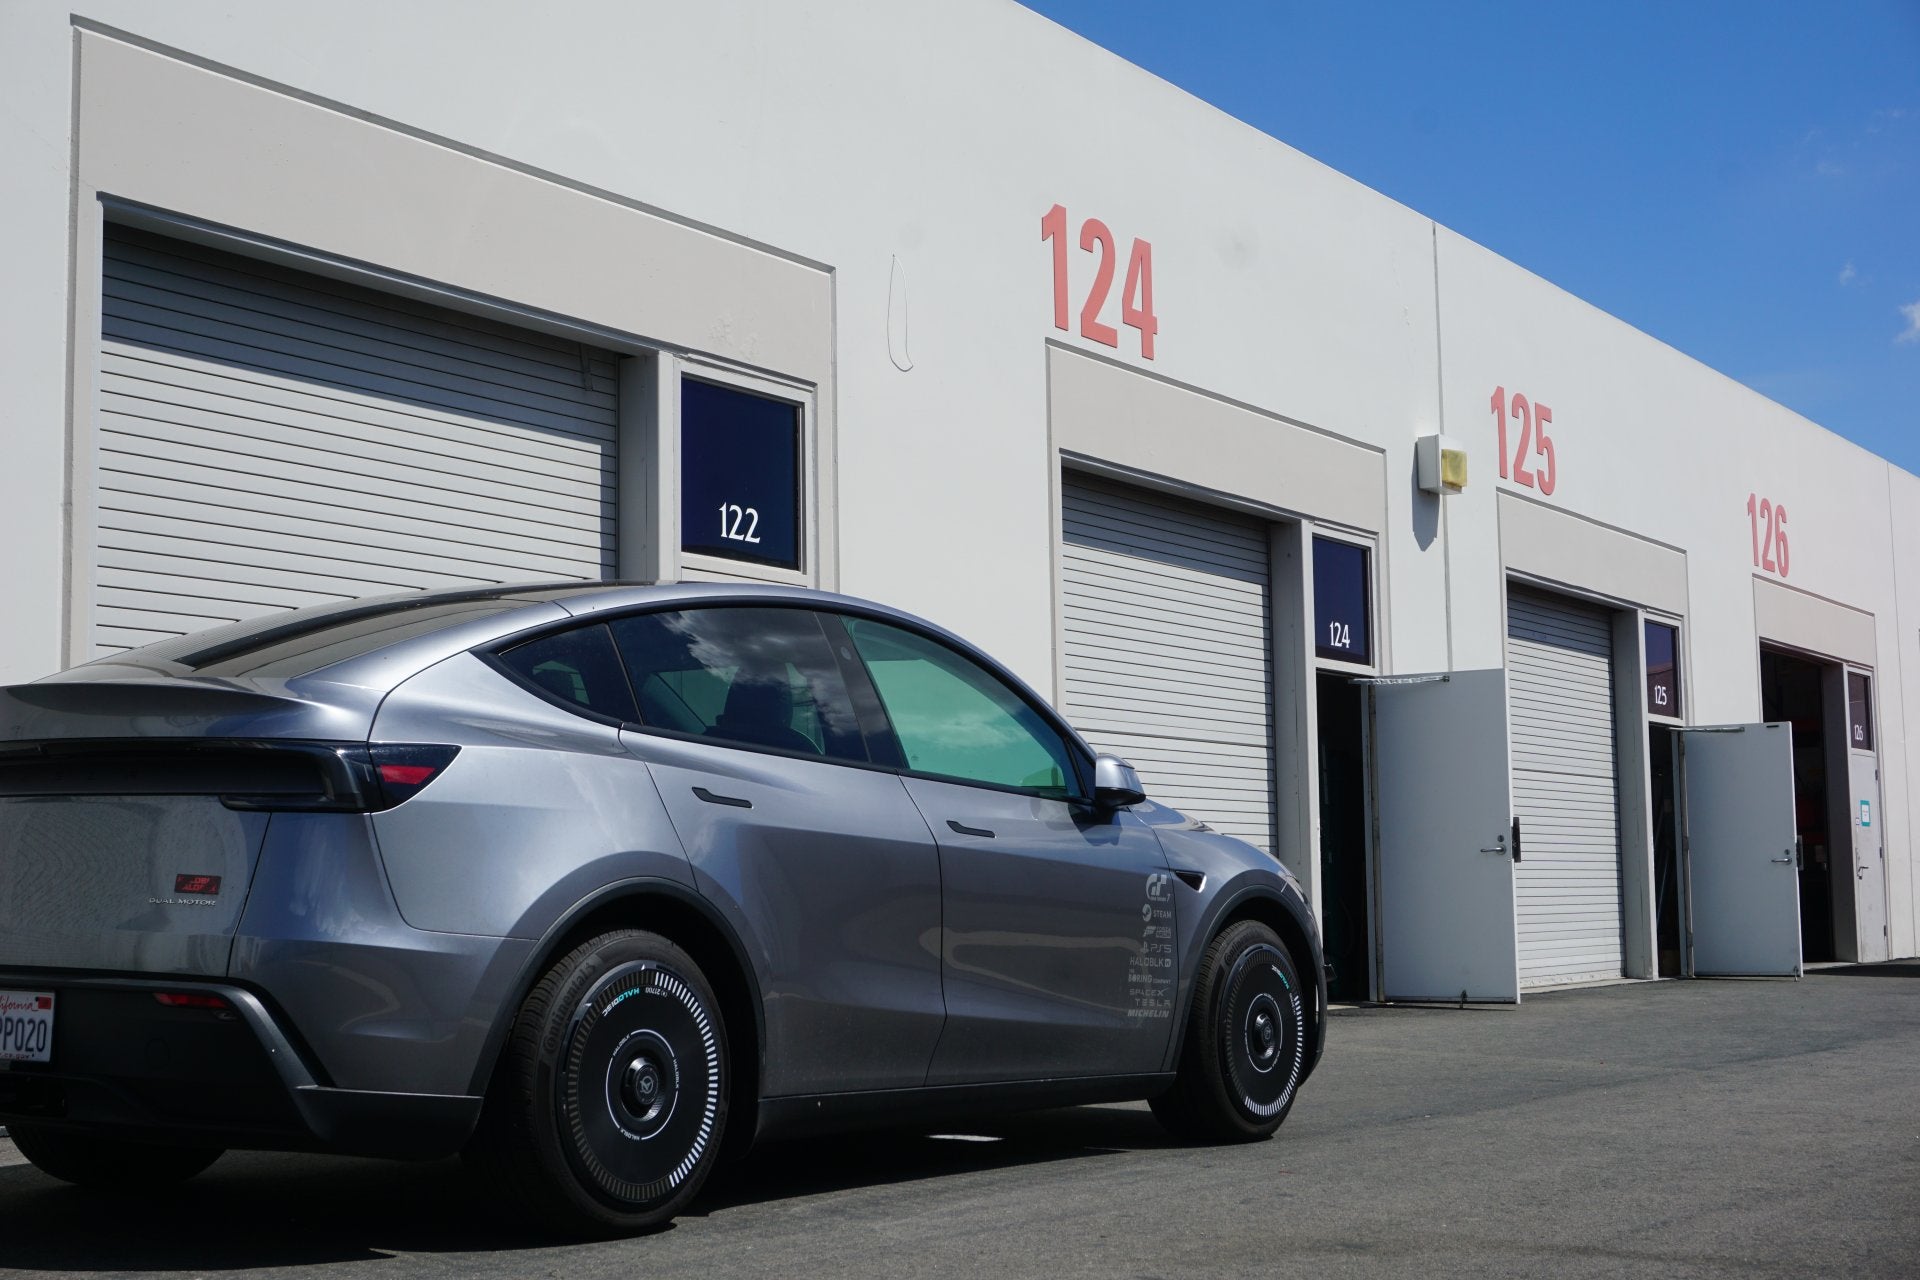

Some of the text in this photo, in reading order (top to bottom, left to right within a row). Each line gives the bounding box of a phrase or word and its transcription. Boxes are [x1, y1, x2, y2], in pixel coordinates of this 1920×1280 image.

[1042, 203, 1157, 360] 124
[1490, 386, 1556, 495] 125
[719, 501, 760, 543] 122
[1747, 492, 1789, 577] 126
[1329, 620, 1350, 648] 124
[1654, 685, 1667, 705] 125
[1854, 724, 1864, 740] 126
[177, 898, 216, 906] MOTOR
[1153, 910, 1171, 919] STEAM
[1150, 944, 1171, 953] PS5
[1129, 956, 1164, 967] HALOBLK
[1128, 974, 1153, 983] BORING
[1129, 987, 1169, 997] SPACEX
[1135, 998, 1171, 1009] TESLA
[1127, 1009, 1169, 1018] MICHELIN
[0, 1017, 47, 1052] P020
